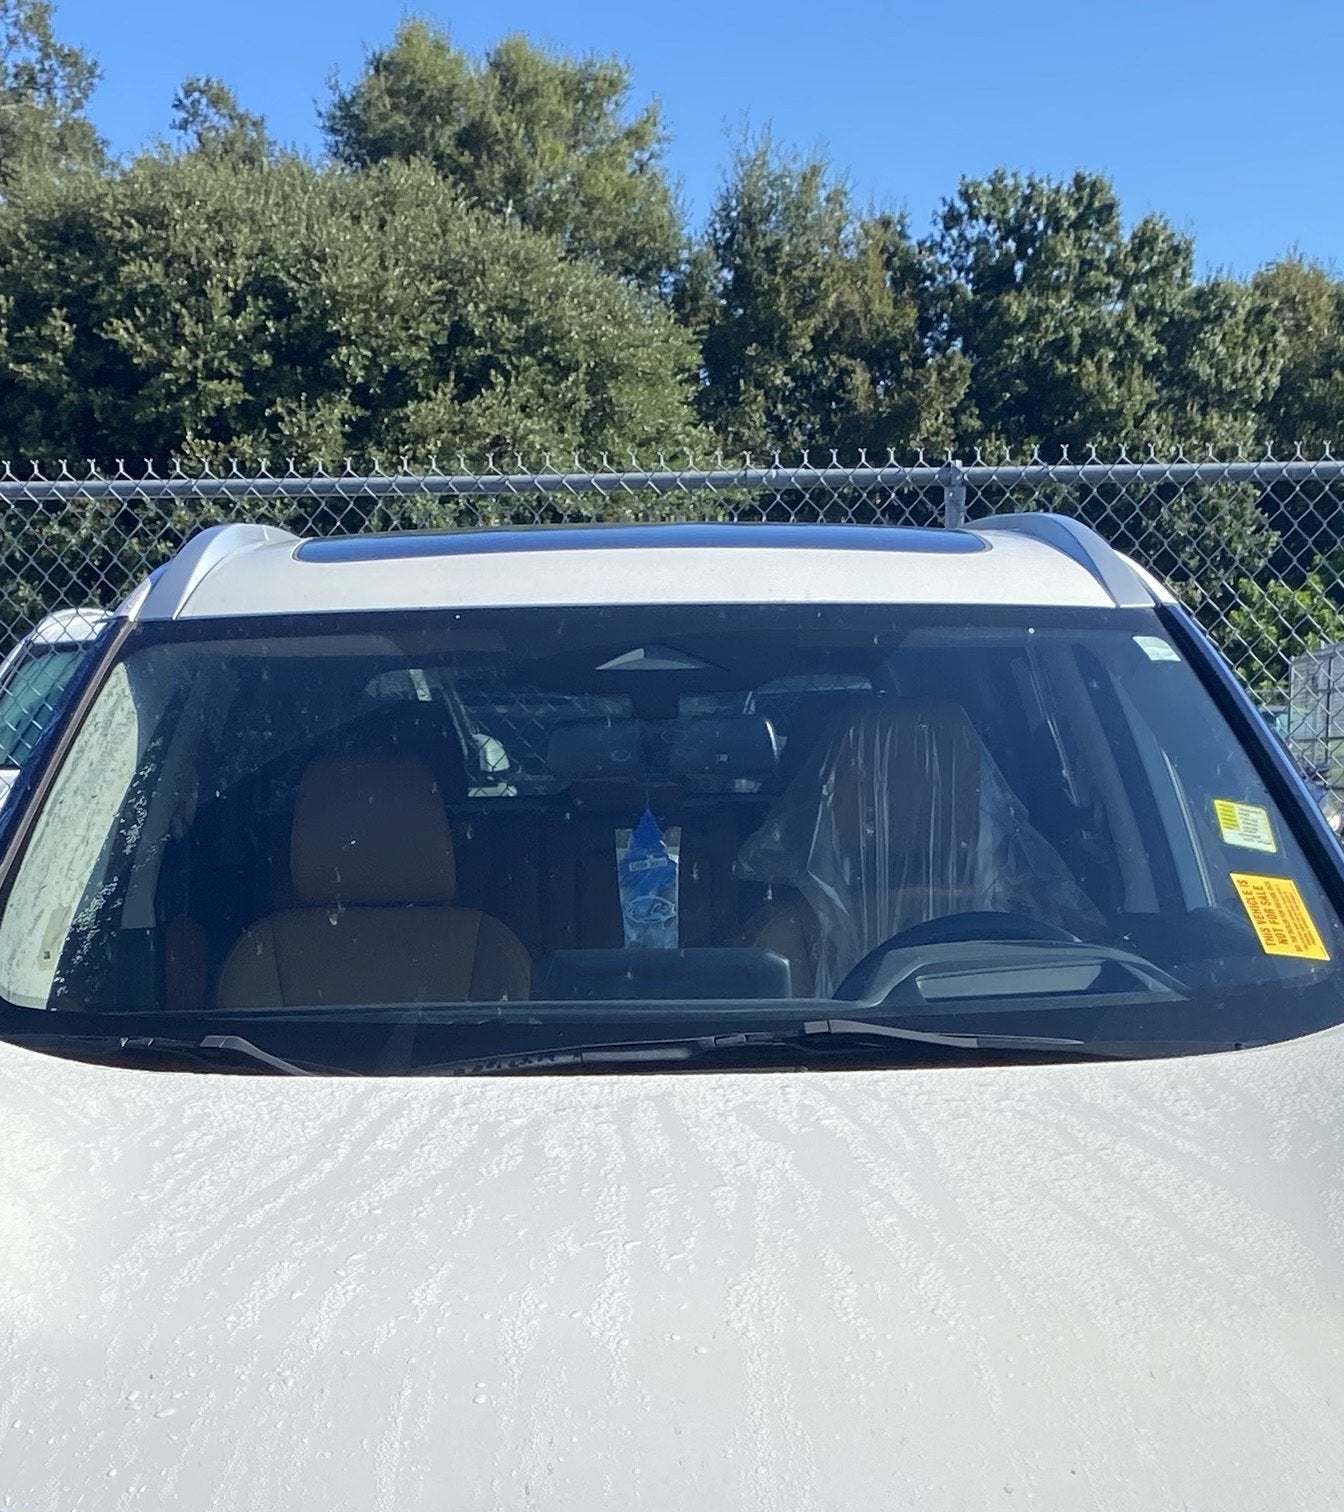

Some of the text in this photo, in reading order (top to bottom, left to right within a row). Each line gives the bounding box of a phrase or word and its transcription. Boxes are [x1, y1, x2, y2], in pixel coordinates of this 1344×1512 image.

[1242, 890, 1267, 924] VEHICLE
[1253, 885, 1289, 945] NOT FOR SALE
[1260, 927, 1277, 946] THIS
